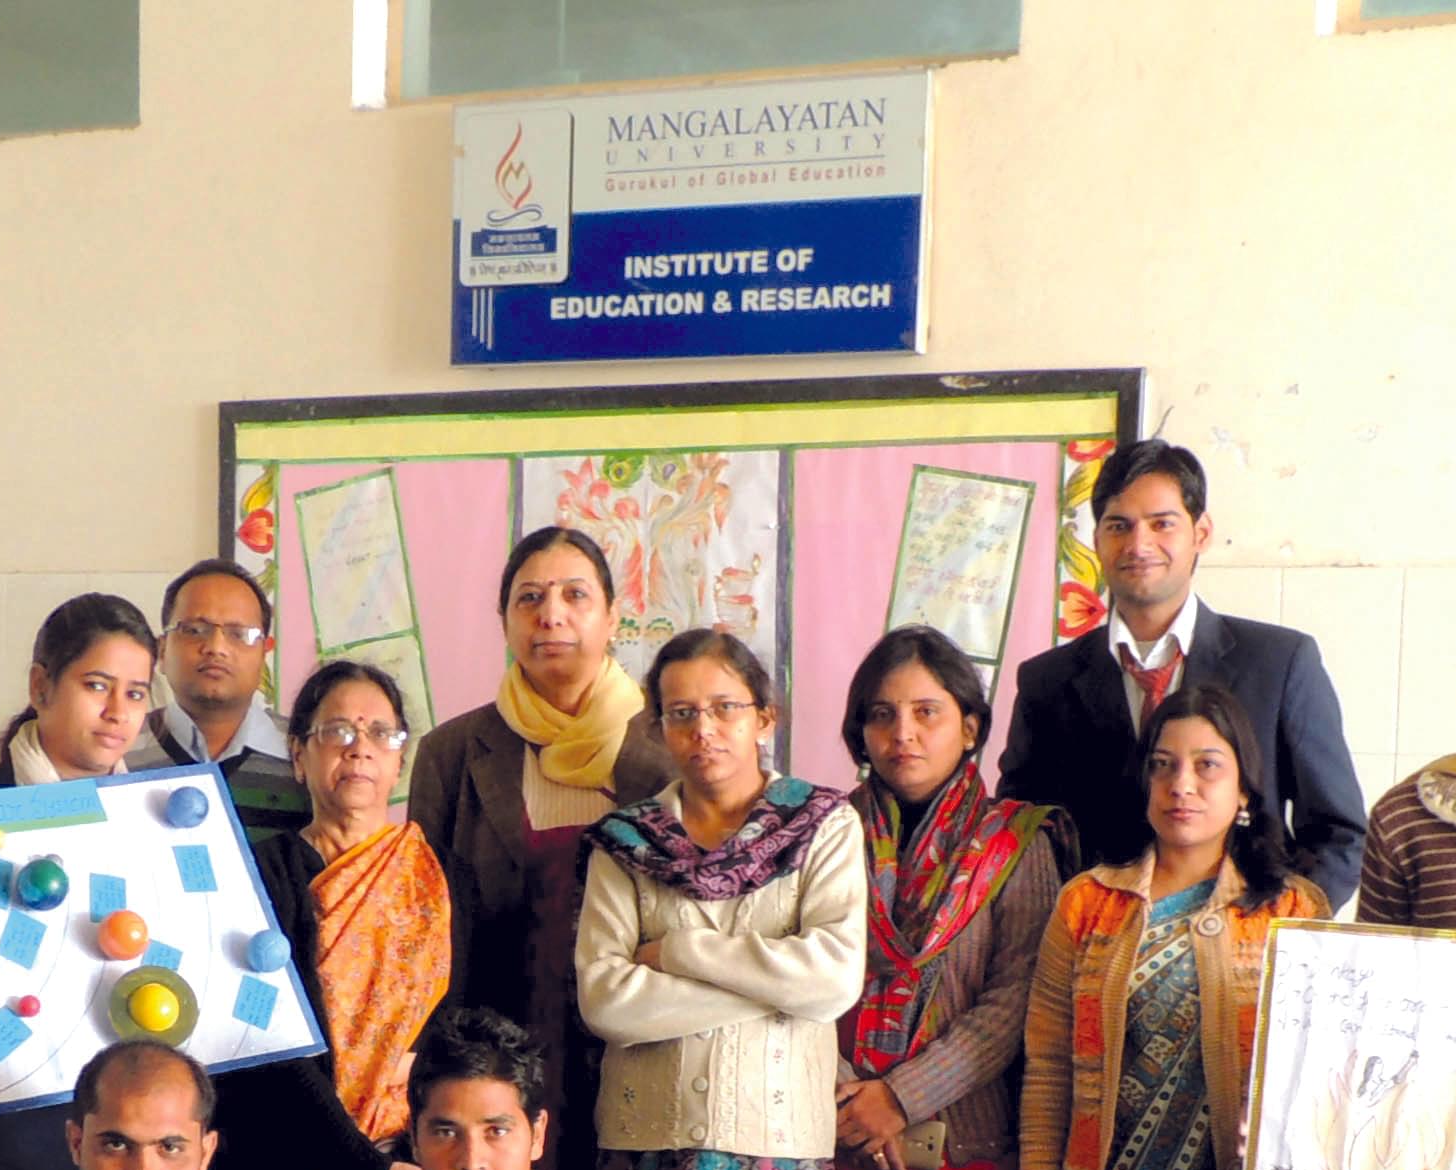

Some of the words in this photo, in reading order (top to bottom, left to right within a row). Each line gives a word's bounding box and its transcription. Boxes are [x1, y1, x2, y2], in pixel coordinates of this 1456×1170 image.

[607, 98, 887, 143] MANGALAYATAN
[606, 133, 887, 166] UNIVERSITY
[605, 175, 678, 193] Gurukul
[688, 171, 705, 188] of
[716, 168, 777, 187] Global
[789, 163, 887, 183] Education
[624, 250, 768, 279] INSTITUTE
[777, 248, 814, 272] OF
[550, 293, 704, 320] EDUCATION
[712, 293, 732, 314] &
[741, 284, 892, 312] RESEARCH
